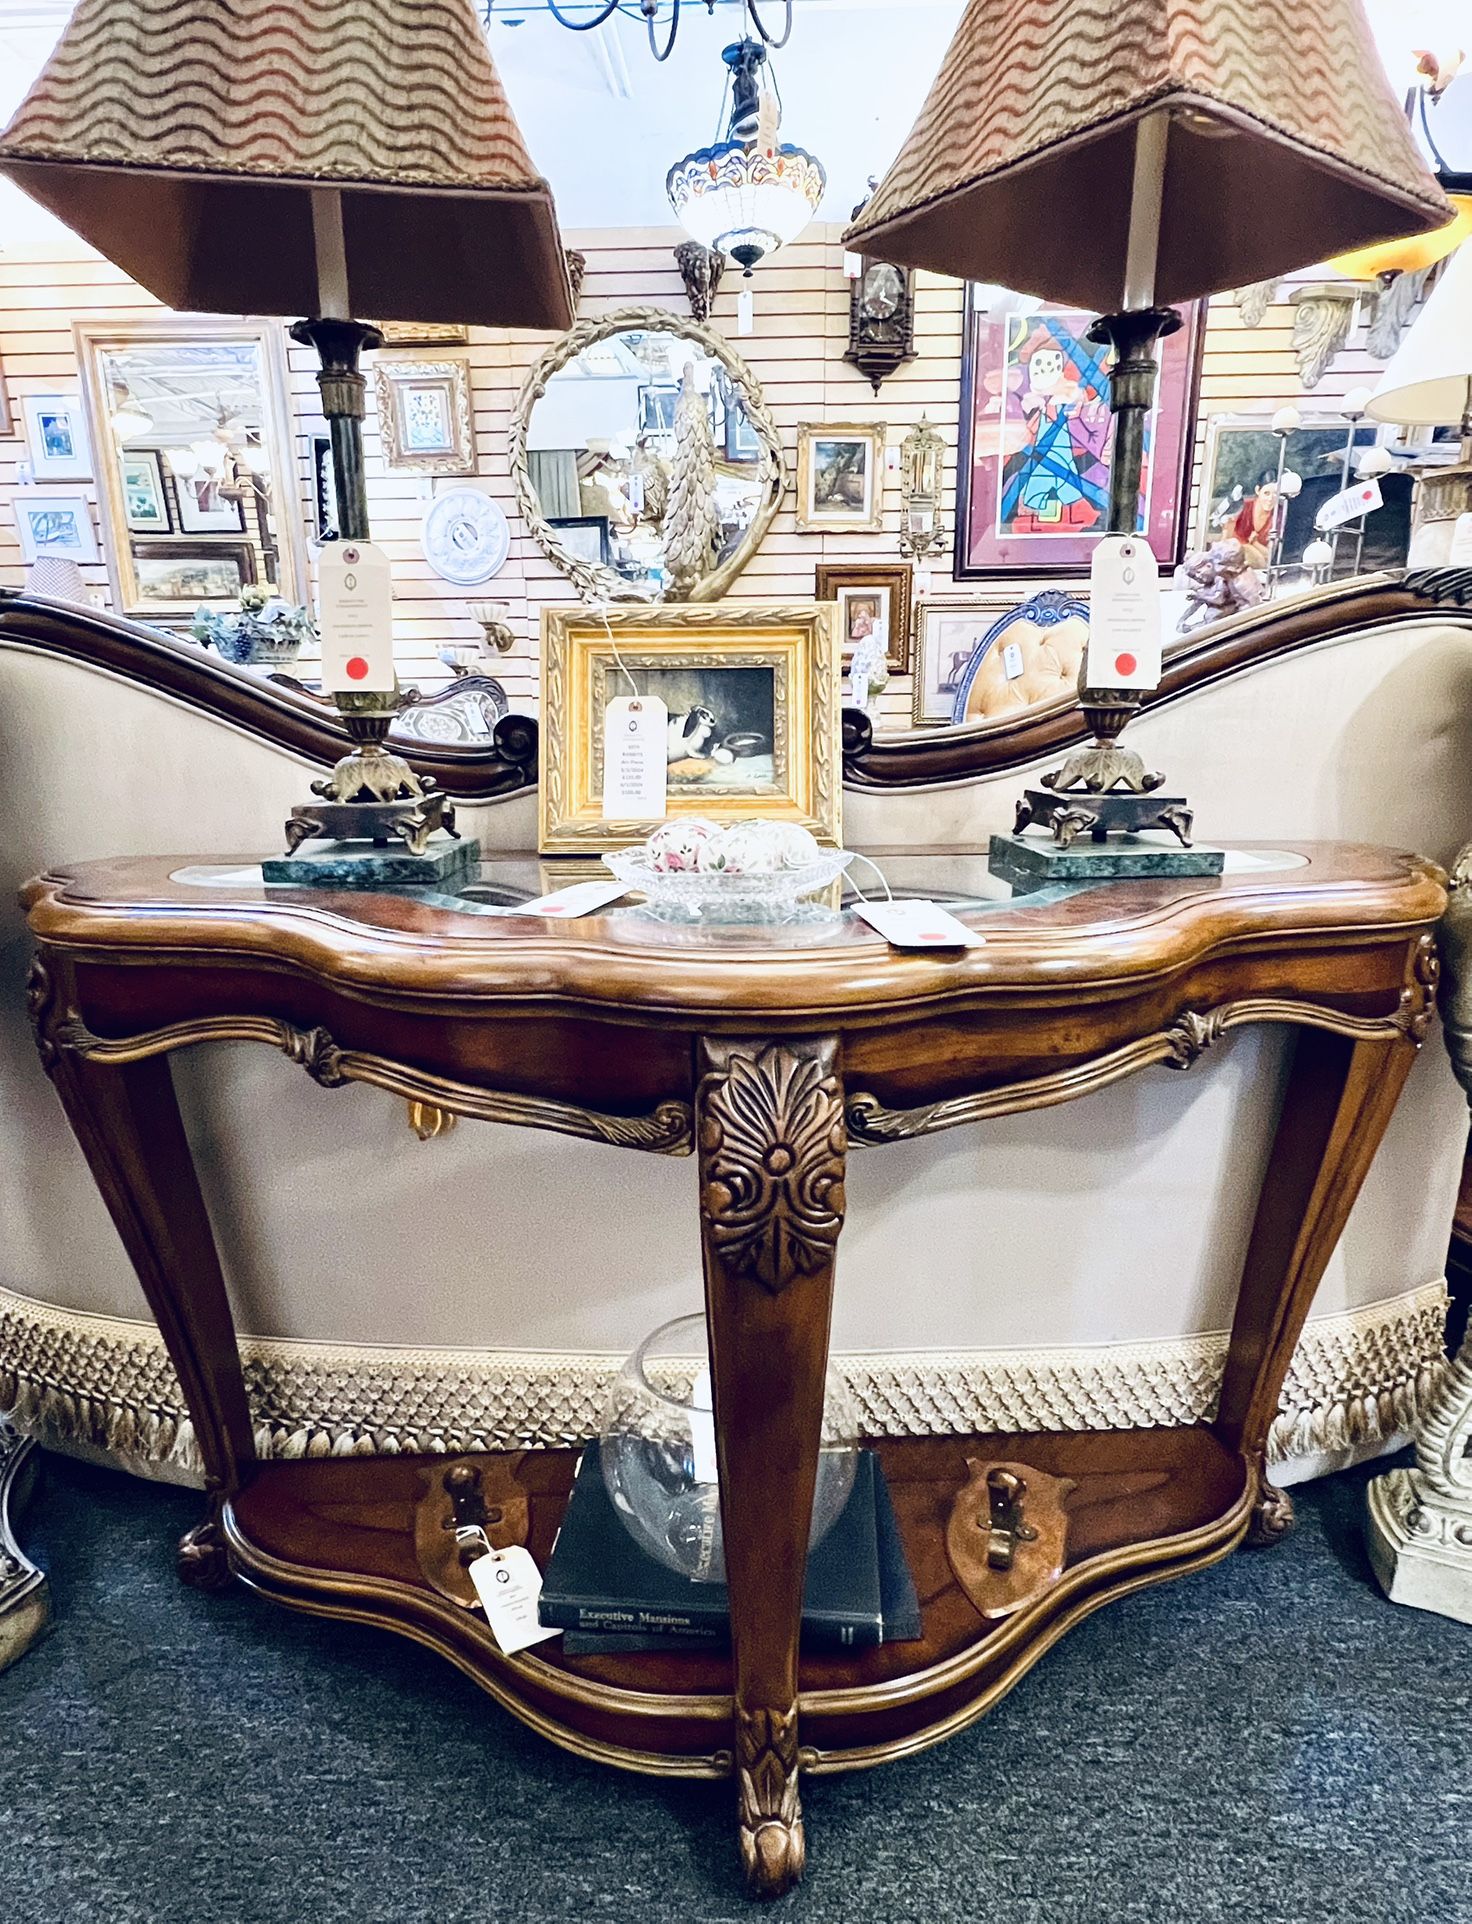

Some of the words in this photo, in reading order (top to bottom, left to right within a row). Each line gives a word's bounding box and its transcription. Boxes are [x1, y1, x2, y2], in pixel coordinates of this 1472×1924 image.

[579, 1608, 635, 1622] Executive
[638, 1612, 691, 1625] Mansions
[579, 1620, 599, 1628] and
